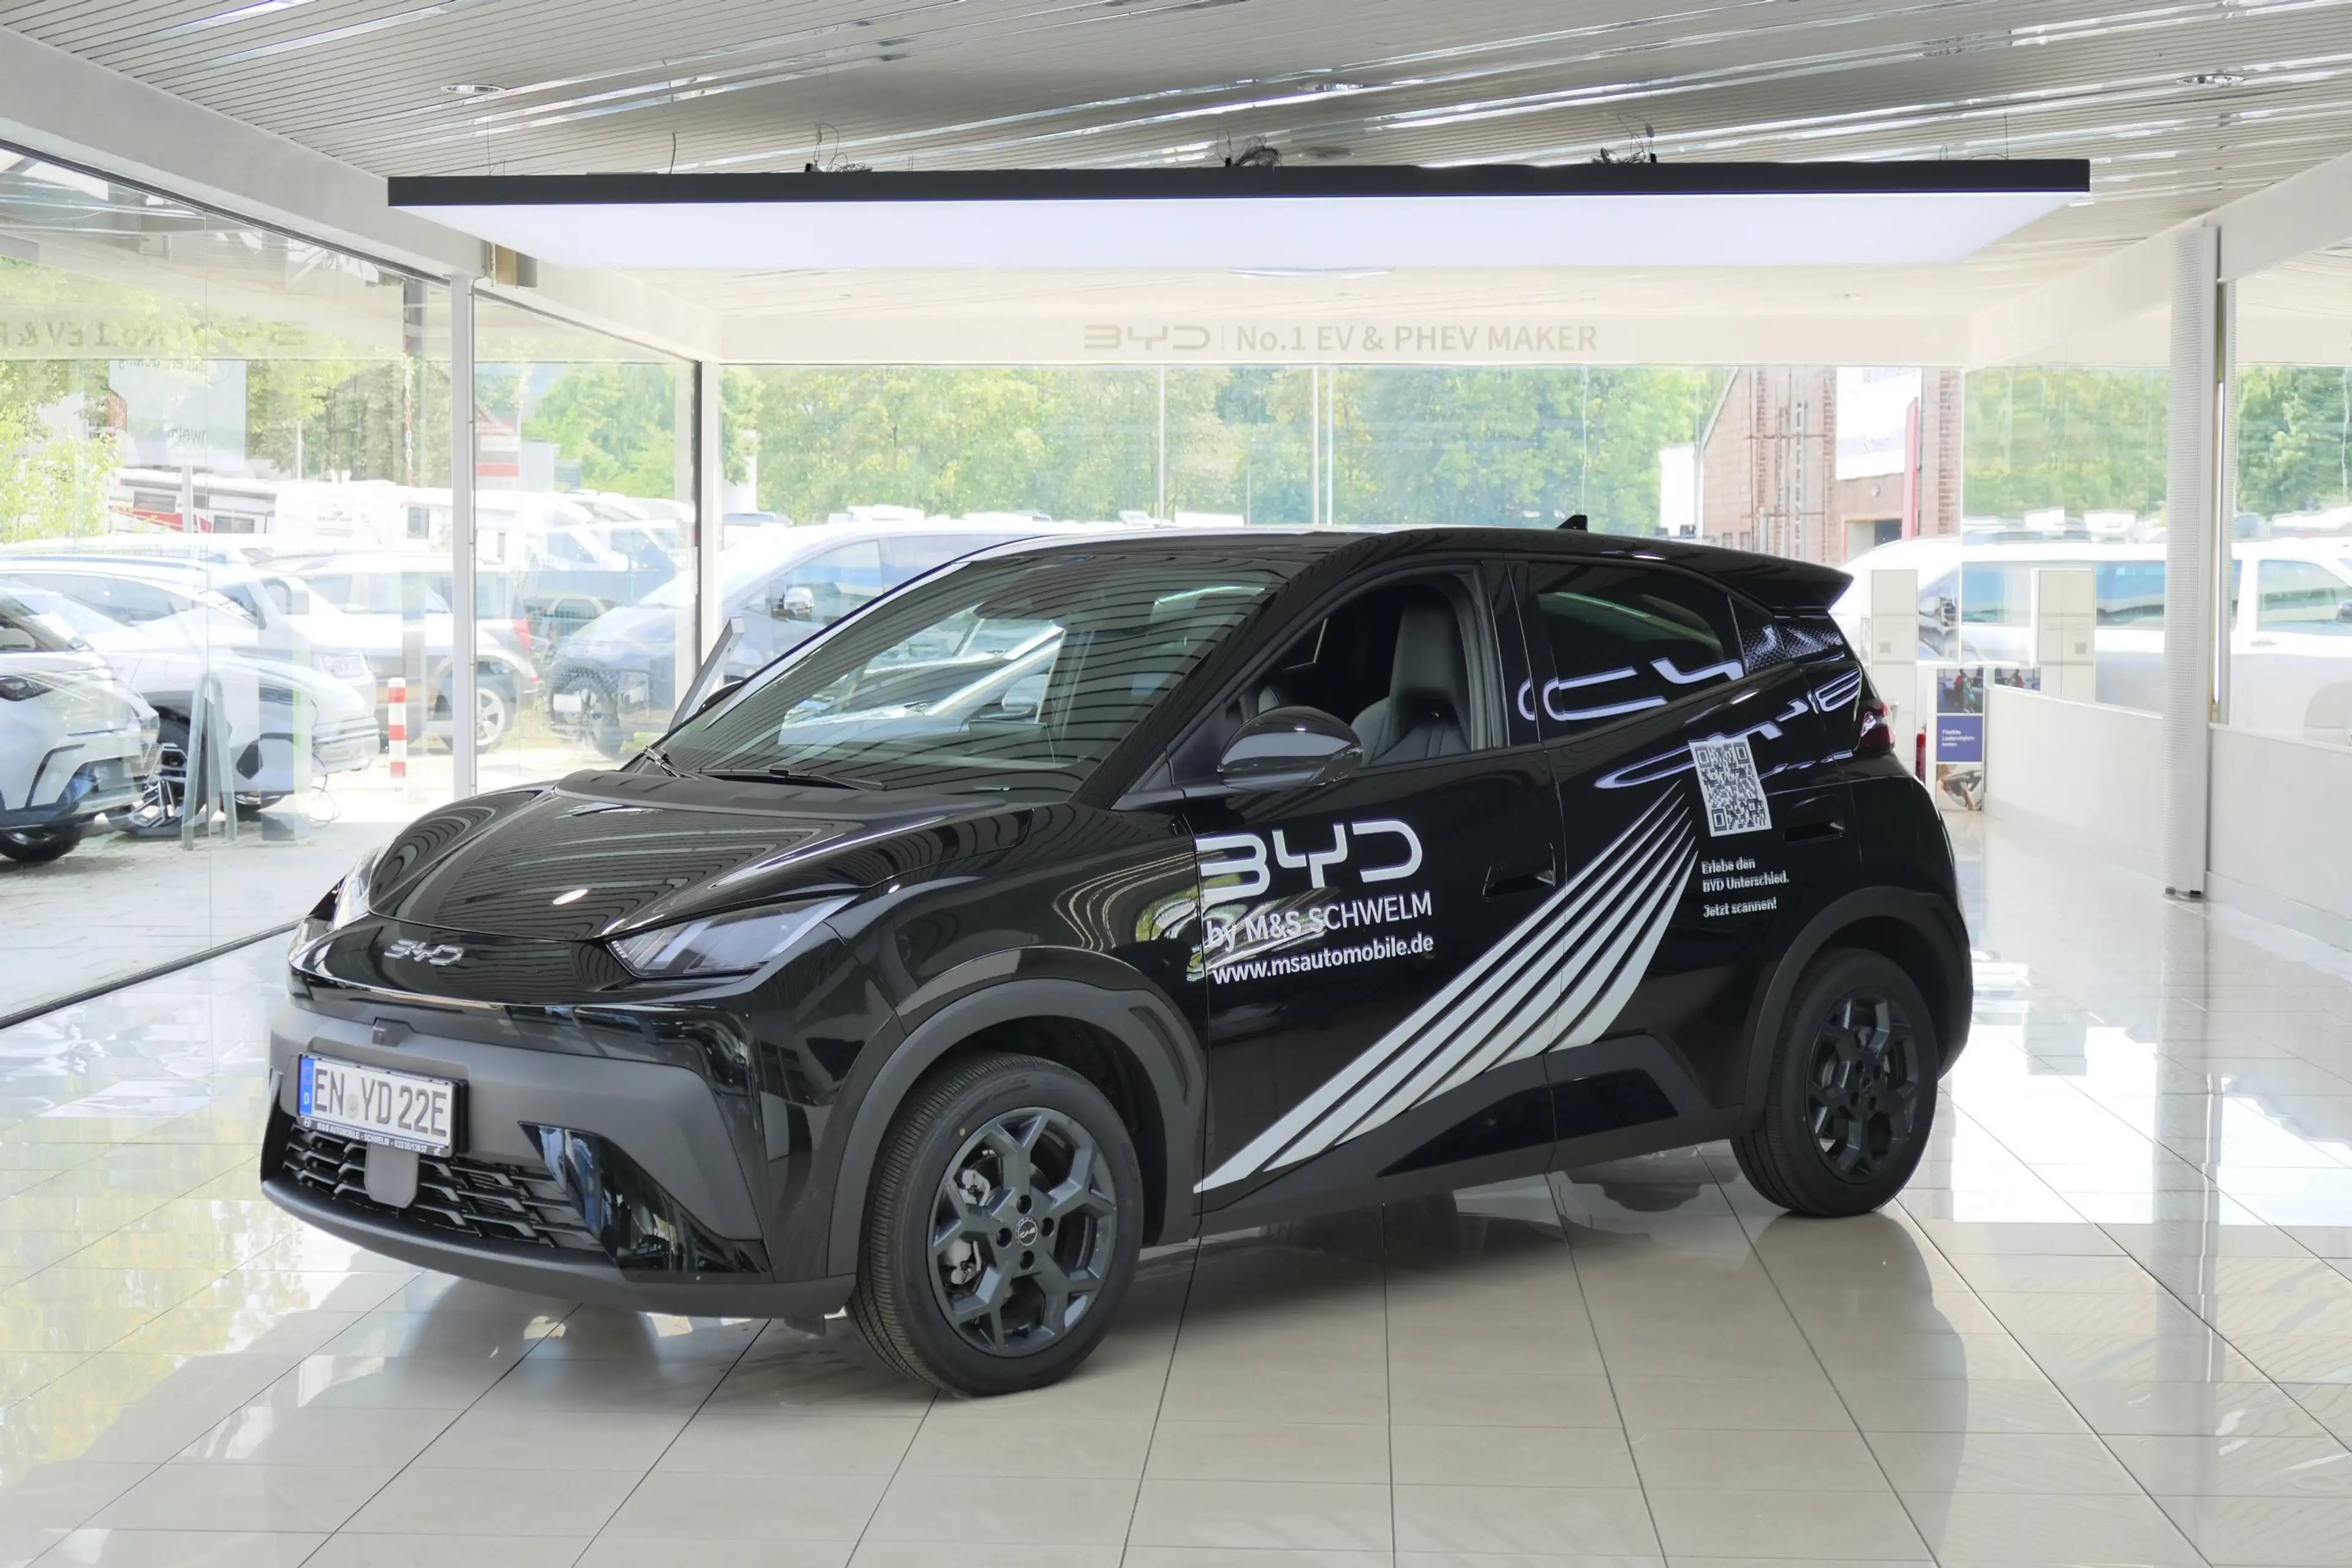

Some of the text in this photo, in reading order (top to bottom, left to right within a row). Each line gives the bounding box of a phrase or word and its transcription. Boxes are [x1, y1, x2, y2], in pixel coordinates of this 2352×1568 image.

[1084, 324, 1597, 352] BYD No.1 EV & PHEV MAKER
[1195, 818, 1423, 903] BYD
[1701, 857, 1755, 875] Erlebe den
[1703, 870, 1789, 892] BYD Unterschied.
[1207, 890, 1433, 952] by M&S SCHWELM
[1703, 897, 1777, 918] Jetzt scannen!
[383, 939, 464, 966] BYD
[1213, 931, 1434, 985] www.msautomobile.de
[314, 1068, 447, 1137] EN YD 22E
